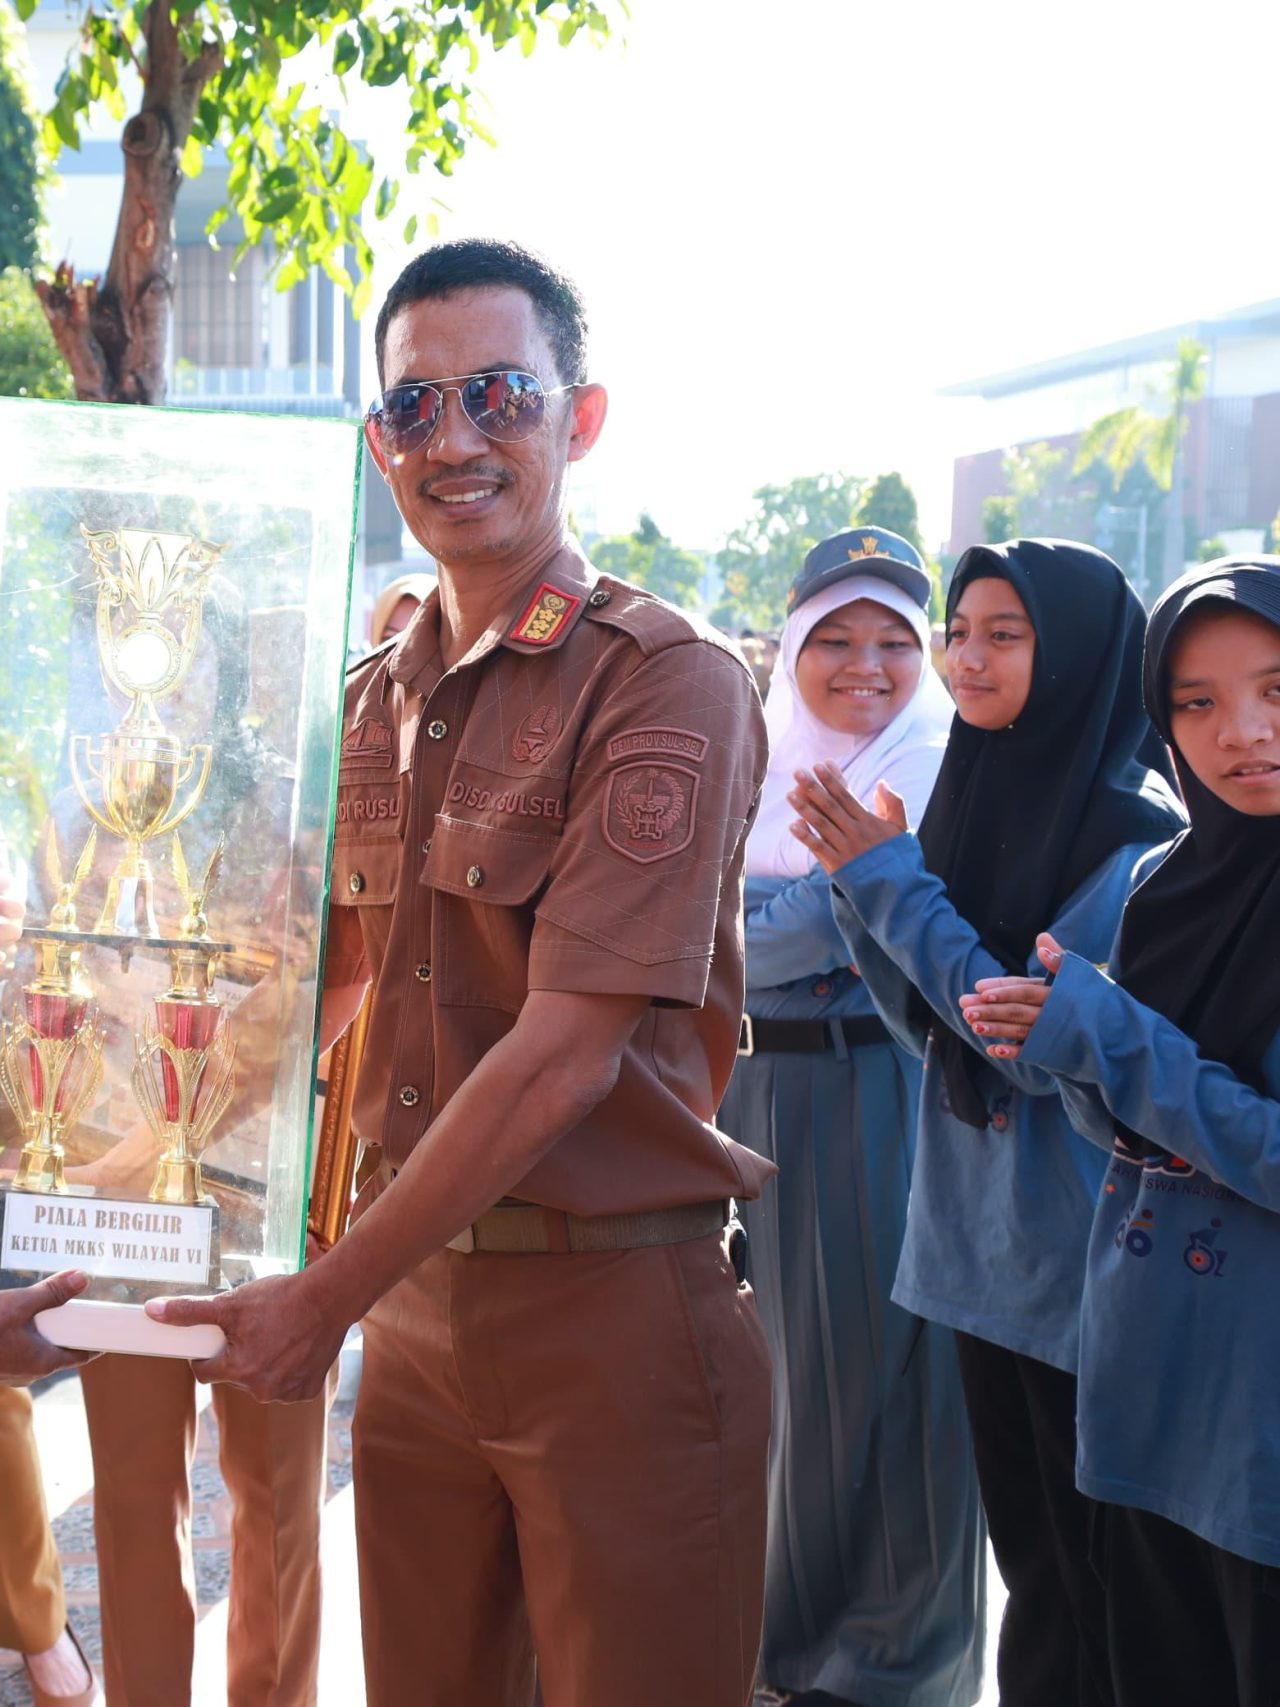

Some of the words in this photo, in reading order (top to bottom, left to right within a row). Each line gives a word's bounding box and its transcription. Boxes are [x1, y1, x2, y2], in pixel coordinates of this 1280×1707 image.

[34, 1204, 87, 1228] PIALA
[94, 1209, 182, 1234] BERGILIR
[11, 1235, 57, 1254] KETUA
[64, 1239, 105, 1258] MKKS
[112, 1242, 180, 1264] WILAYAH
[186, 1248, 202, 1265] VI
